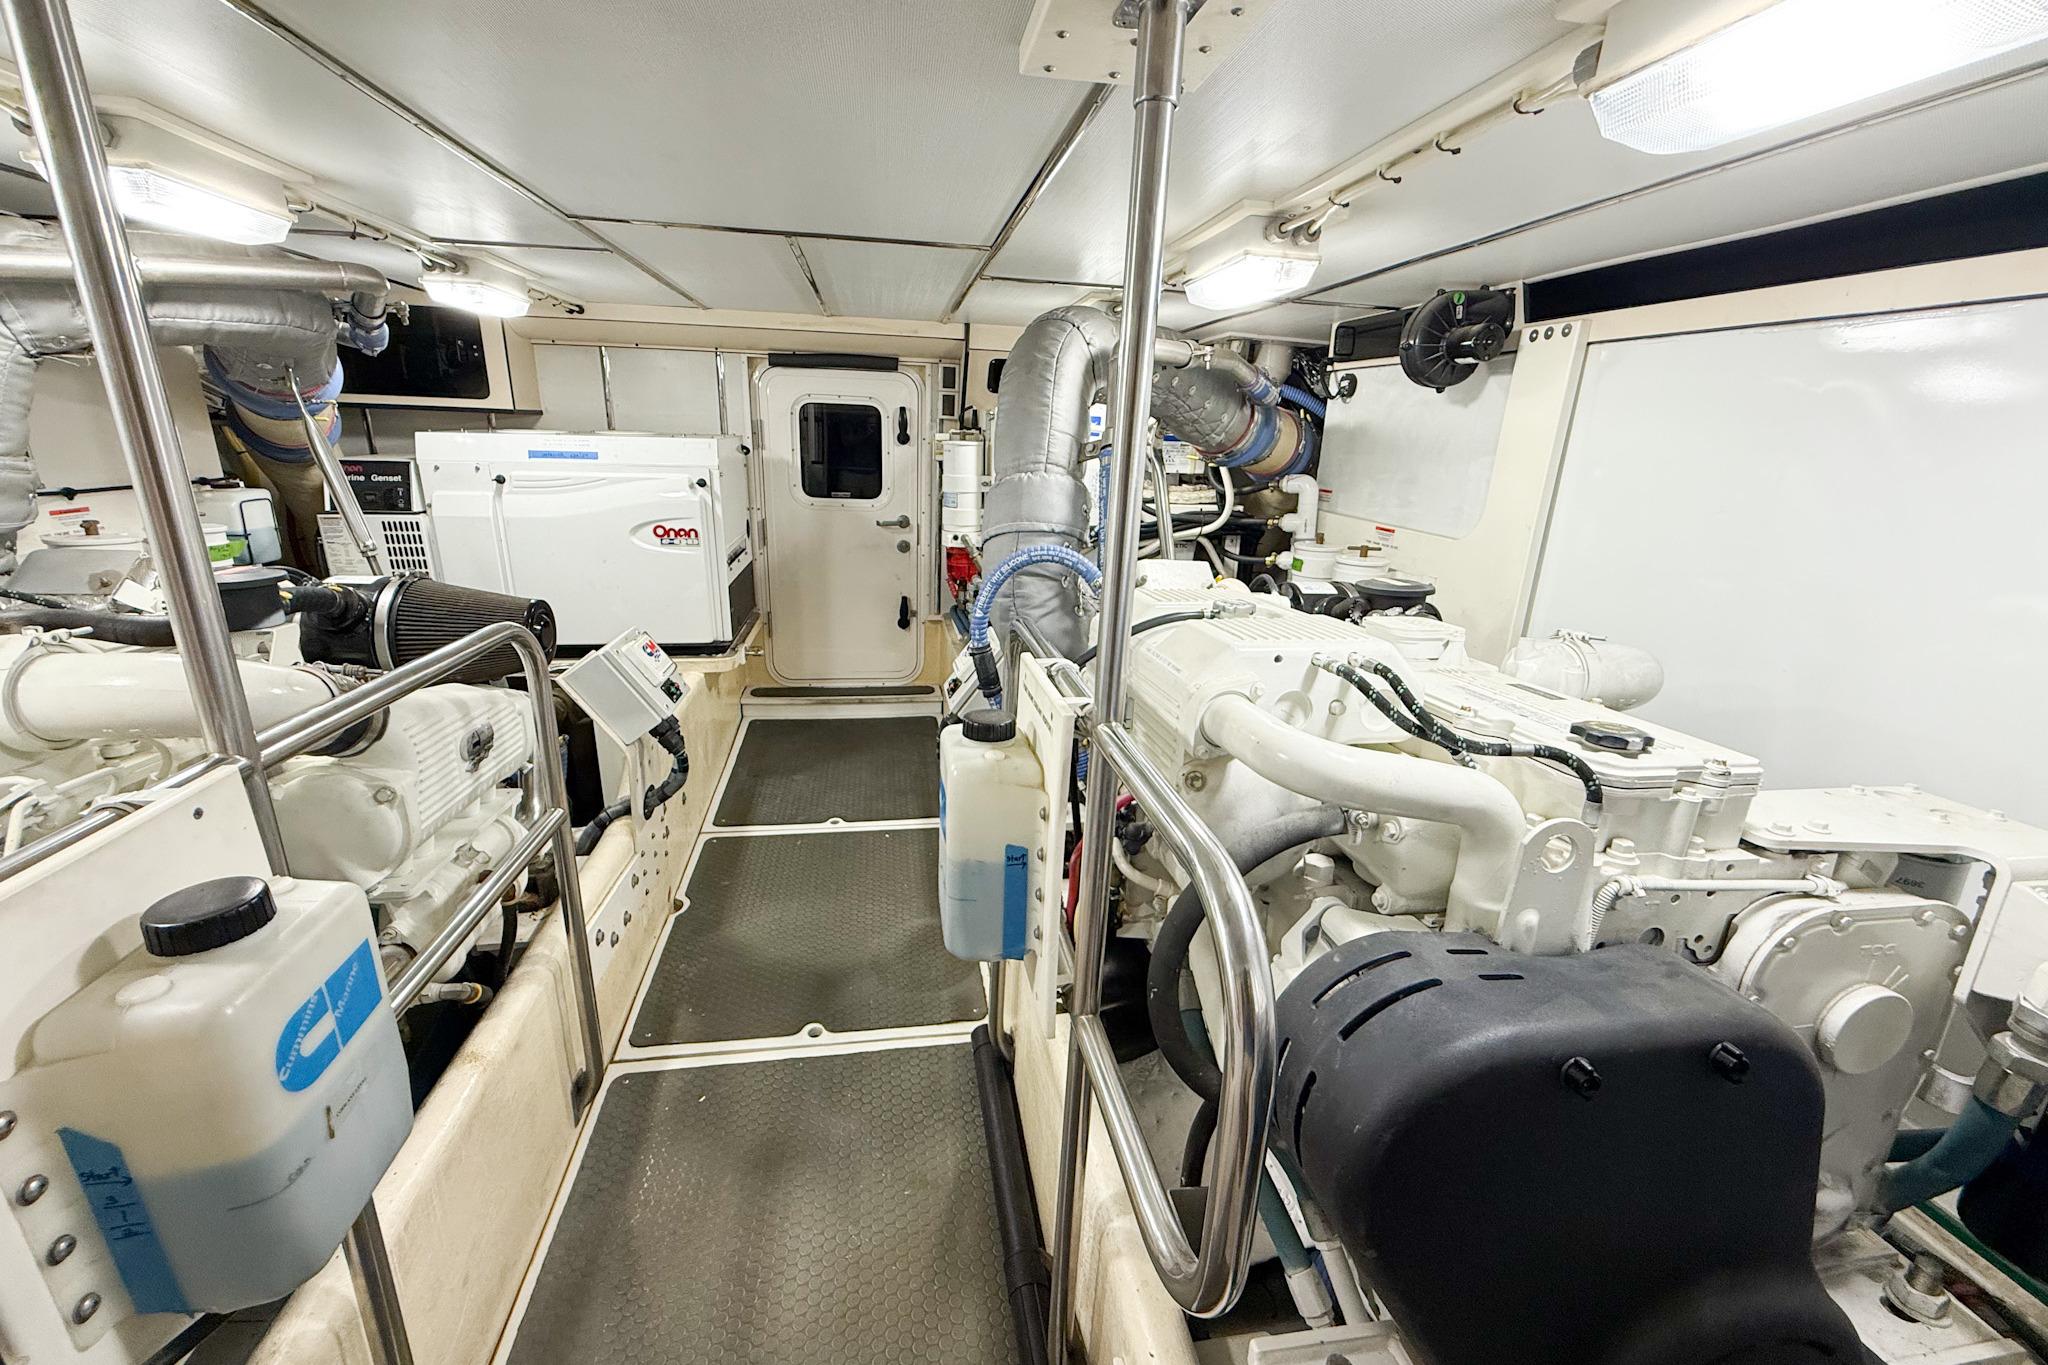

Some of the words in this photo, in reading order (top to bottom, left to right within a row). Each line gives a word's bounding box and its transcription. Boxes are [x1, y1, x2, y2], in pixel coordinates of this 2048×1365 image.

[653, 525, 698, 538] Onan
[978, 582, 993, 609] TRIDENT
[991, 572, 1002, 584] VHT
[1001, 553, 1029, 573] SILICONE
[280, 993, 319, 1081] Cummins
[335, 960, 359, 1018] Marine
